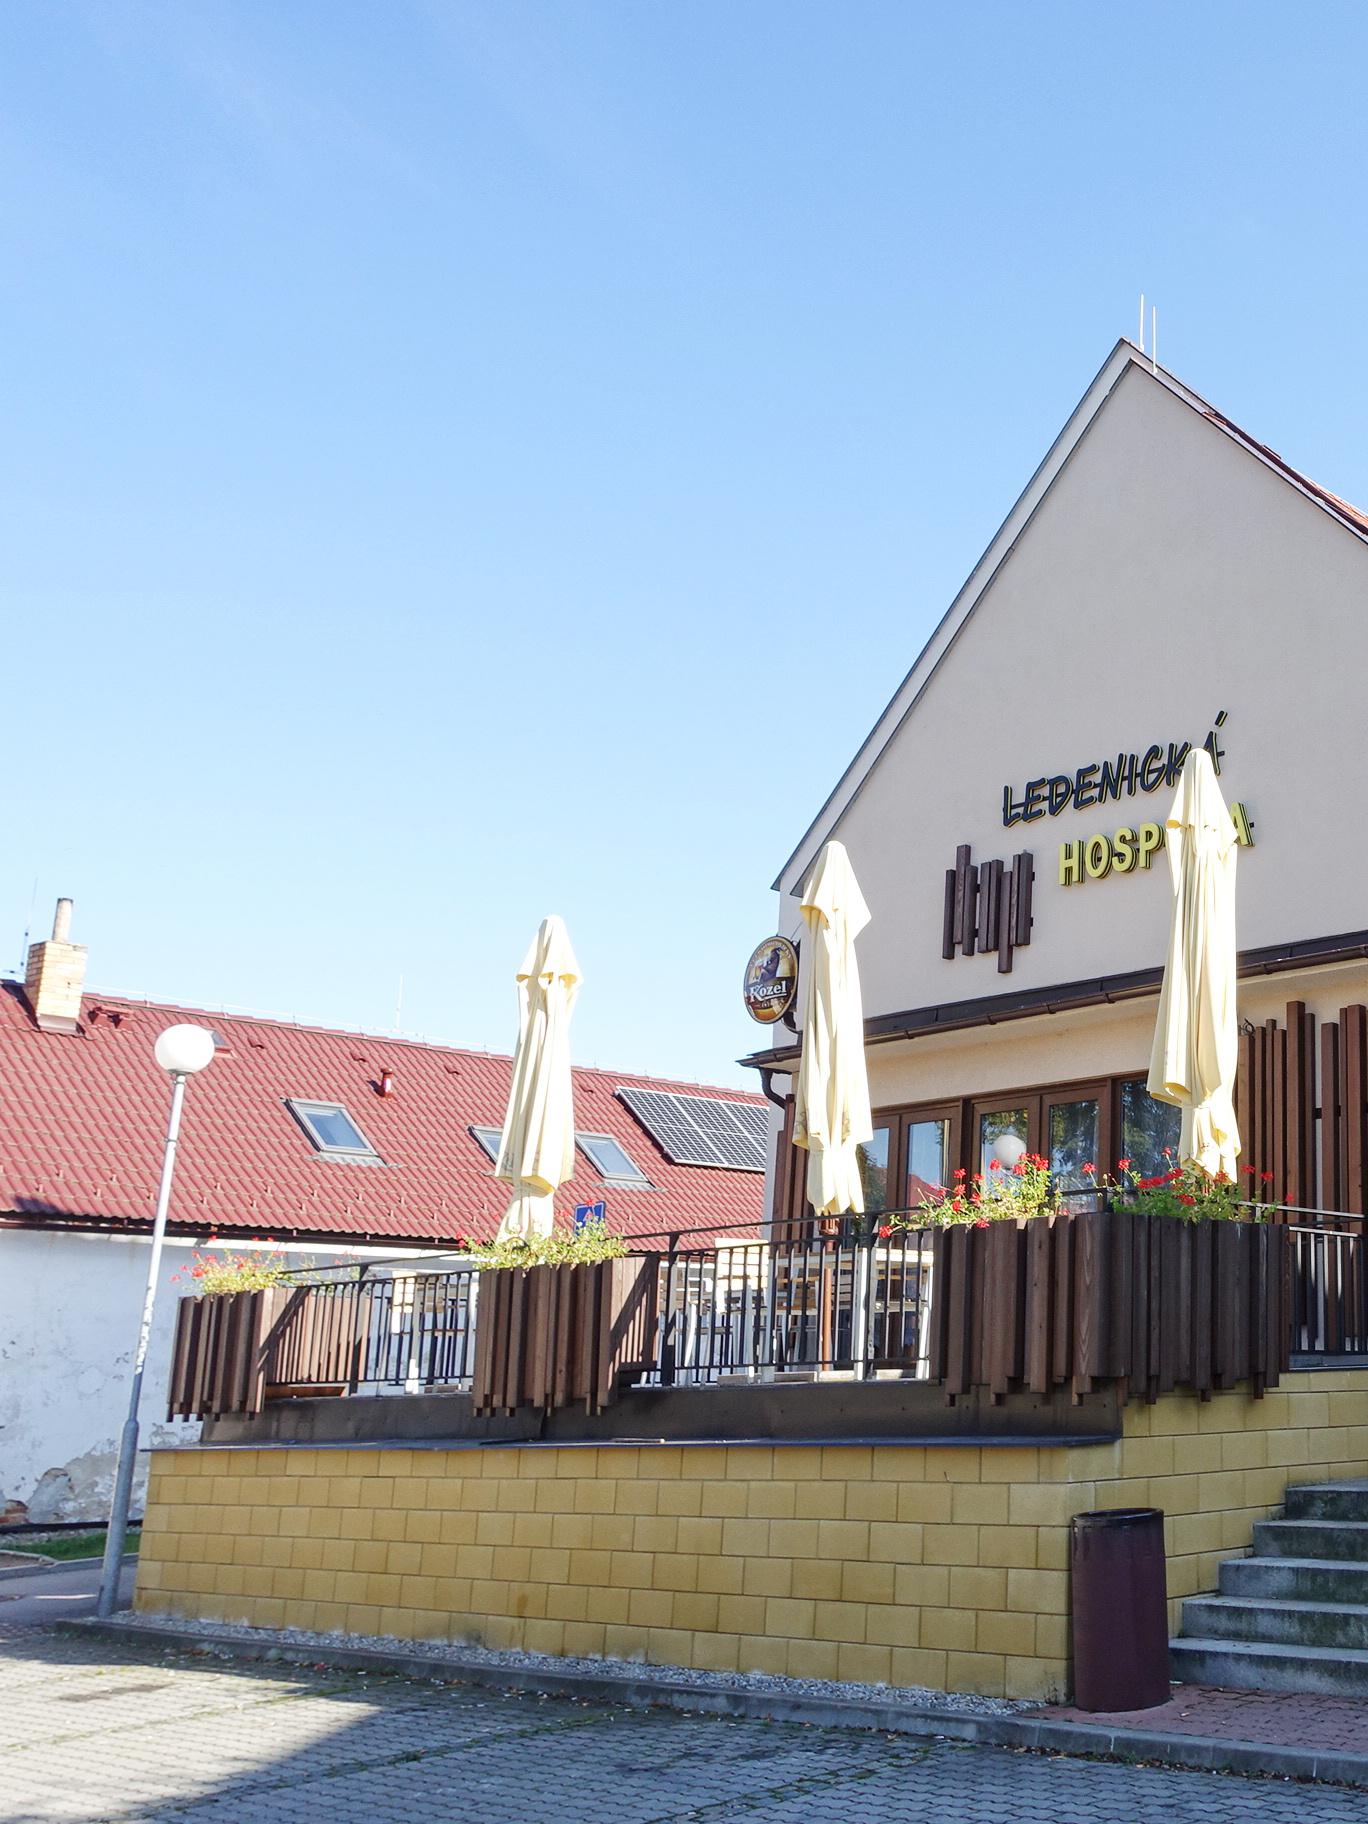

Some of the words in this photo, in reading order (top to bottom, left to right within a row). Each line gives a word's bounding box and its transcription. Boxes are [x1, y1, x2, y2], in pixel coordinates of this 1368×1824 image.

[1002, 710, 1227, 828] LEDENICKÁ
[1058, 801, 1254, 886] HOSPA
[749, 980, 787, 1003] Kozel
